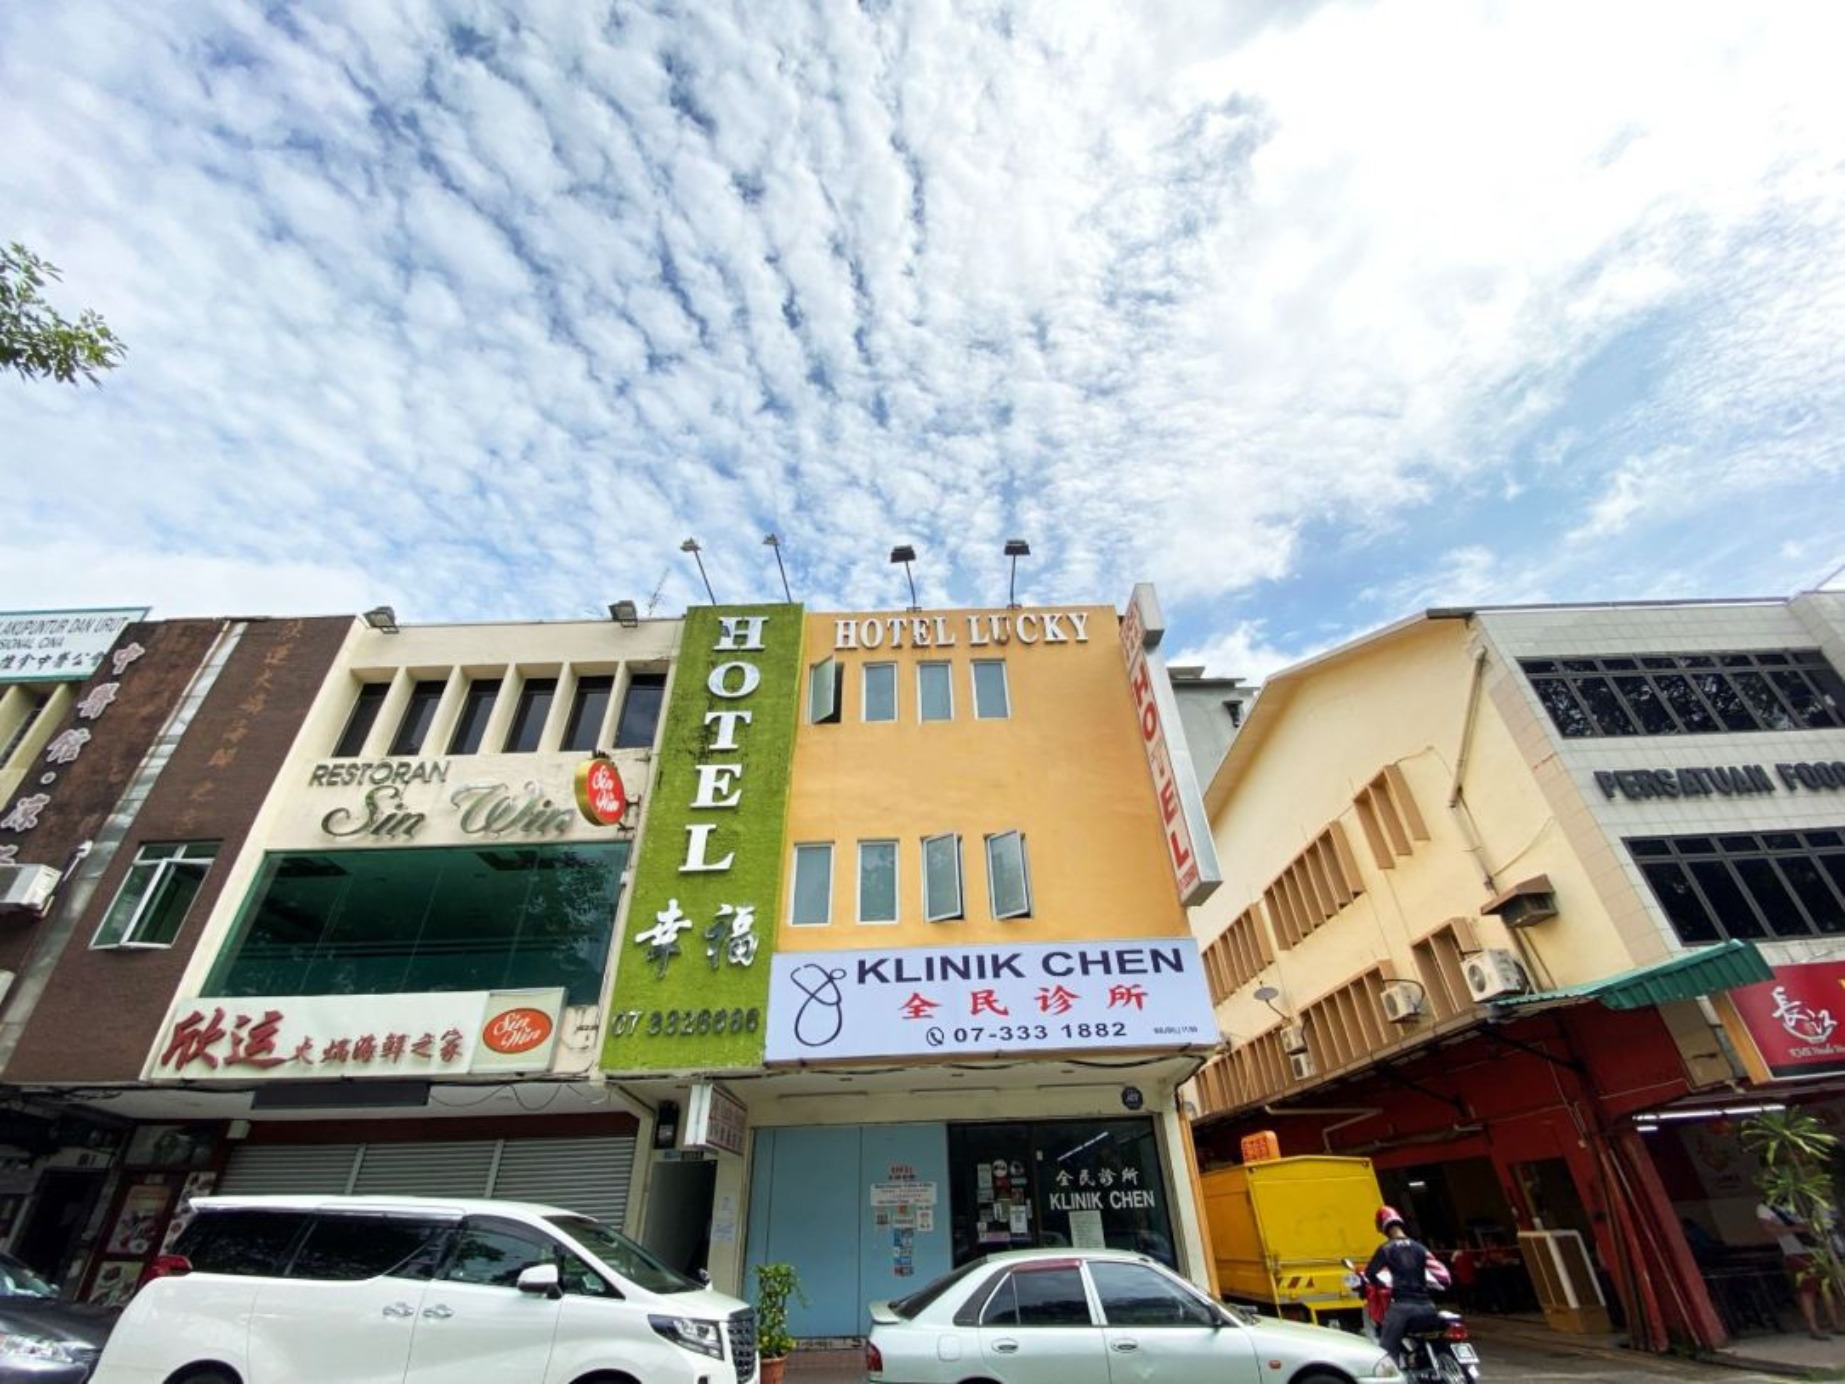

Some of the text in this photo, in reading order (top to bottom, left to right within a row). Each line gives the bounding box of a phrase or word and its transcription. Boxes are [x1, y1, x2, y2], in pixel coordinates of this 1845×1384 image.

[833, 615, 956, 649] HOTEL
[967, 611, 1090, 647] LUCKY
[678, 615, 769, 874] HOTEL
[308, 759, 452, 788] RESTORAN
[1593, 764, 1778, 802] PERSATUAN
[321, 779, 578, 839] Sin Win
[634, 898, 760, 980] 幸福
[856, 947, 1185, 985] KLINIK CHEN
[898, 982, 1149, 1021] 全民诊所
[493, 1012, 530, 1037] Sin
[501, 1028, 542, 1050] Win
[612, 1010, 643, 1036] 07
[953, 1021, 1128, 1044] 07-333 1882
[1048, 1189, 1156, 1211] KLINIK CHEN
